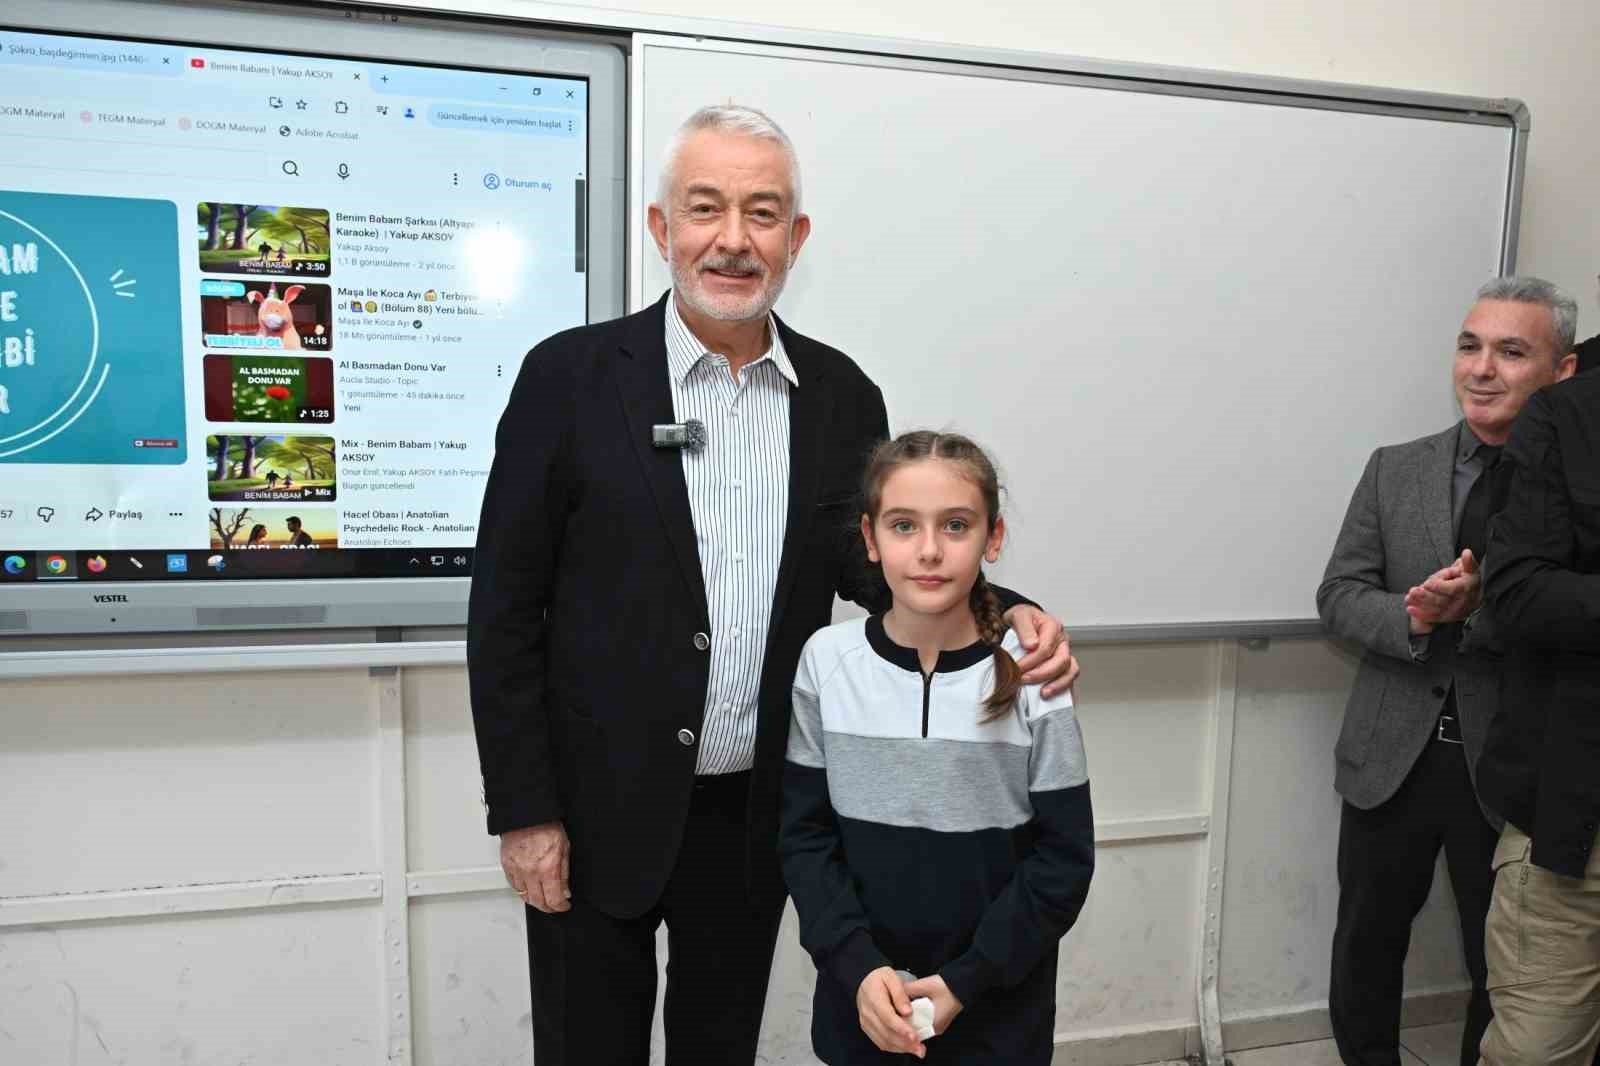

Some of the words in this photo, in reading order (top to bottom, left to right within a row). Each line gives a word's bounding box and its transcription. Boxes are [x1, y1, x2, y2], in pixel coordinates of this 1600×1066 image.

[277, 66, 302, 78] Yakup
[25, 108, 65, 120] Materyal
[127, 116, 165, 127] Materyal
[229, 123, 266, 134] Materyal
[295, 128, 323, 138] Adobe
[326, 130, 359, 140] Acrobat
[504, 177, 538, 190] Oturum
[541, 181, 552, 192] aç
[335, 212, 366, 223] Benim
[369, 214, 402, 225] Babam
[405, 216, 437, 228] Şarkısı
[336, 228, 379, 239] Karaoke)
[389, 230, 419, 241] Yakup
[421, 231, 454, 241] AKSOY
[337, 243, 362, 252] Yakup
[364, 244, 389, 253] Aksoy
[305, 263, 326, 271] 3:50
[337, 287, 364, 298] Maşa
[381, 288, 404, 298] Koca
[407, 290, 421, 300] Ayı
[338, 302, 347, 310] ol
[381, 302, 415, 314] (Bölüm
[417, 304, 433, 315] 88)
[435, 305, 455, 314] Yeni
[338, 317, 361, 327] Maşa
[374, 318, 396, 327] Koca
[303, 336, 328, 345] 14:18
[239, 367, 250, 375] AL
[251, 367, 300, 376] BASMADAN
[339, 361, 349, 369] Al
[352, 361, 401, 370] Basmadan
[404, 362, 428, 371] Donu
[430, 363, 446, 372] Var
[247, 376, 273, 384] DONU
[274, 377, 291, 385] VAR
[365, 376, 389, 384] Studio
[397, 377, 419, 386] Topic
[344, 404, 361, 412] Yeni
[310, 410, 329, 418] 1:25
[341, 440, 359, 448] Mix
[367, 440, 397, 448] Benim
[400, 440, 431, 449] Babam
[438, 441, 467, 451] Yakup
[341, 454, 375, 462] AKSOY
[382, 469, 407, 478] Yakup
[244, 490, 271, 499] BENİM
[272, 491, 302, 499] BABAM
[315, 488, 331, 496] Mix
[109, 510, 143, 520] Paylaş
[343, 511, 370, 519] Hacel
[372, 511, 399, 519] Obası
[406, 511, 449, 519] Anatolian
[343, 523, 399, 533] Psychedelic
[401, 524, 424, 532] Rock
[432, 524, 475, 532] Anatolian
[343, 538, 381, 546] Anatolian
[383, 538, 411, 546] Echoes
[93, 594, 128, 603] VESTEL
